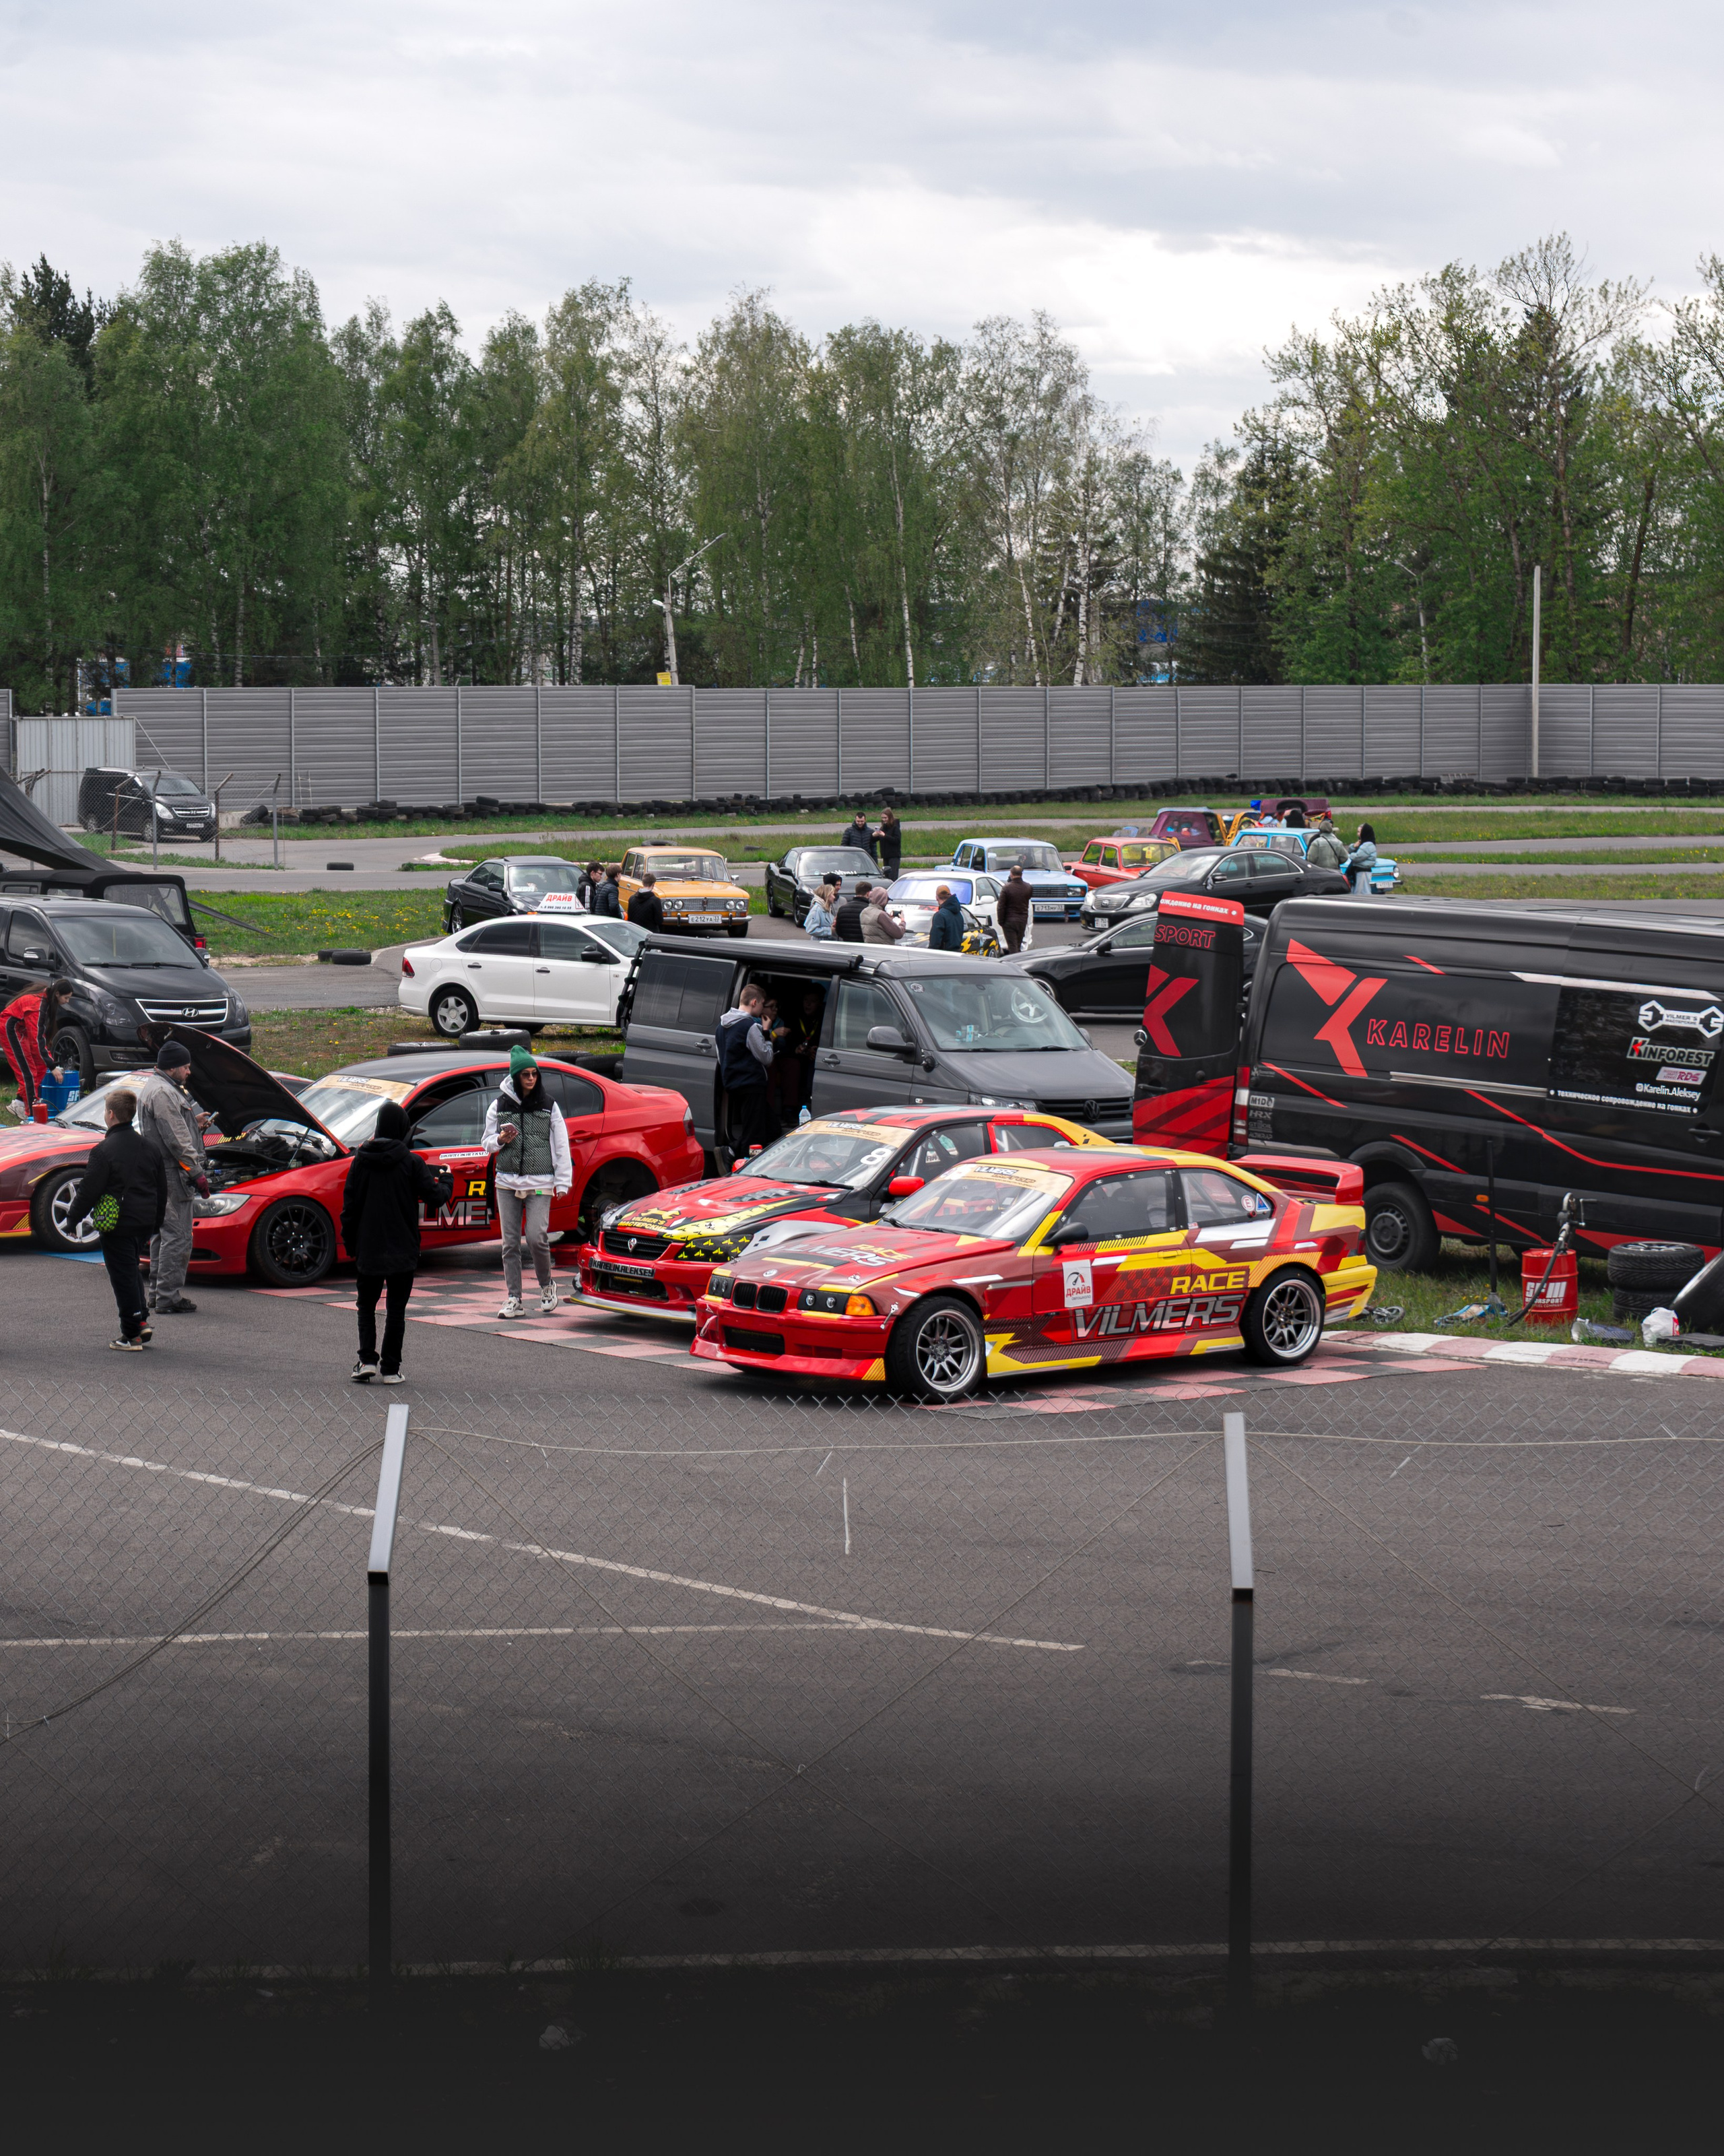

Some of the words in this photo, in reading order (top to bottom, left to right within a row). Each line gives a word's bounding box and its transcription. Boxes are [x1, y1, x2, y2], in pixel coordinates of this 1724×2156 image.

[545, 894, 573, 902] ДРАЙВ
[1154, 924, 1216, 948] SPORT
[1366, 1018, 1510, 1058] KARELIN
[1626, 1037, 1715, 1068] KINFOREST
[1677, 1071, 1701, 1082] RDS
[860, 1147, 892, 1165] 8
[851, 1243, 914, 1261] RACE
[1065, 1284, 1091, 1298] ДРАЙВ
[1170, 1270, 1246, 1295] RACE
[1075, 1293, 1245, 1339] VILMERS
